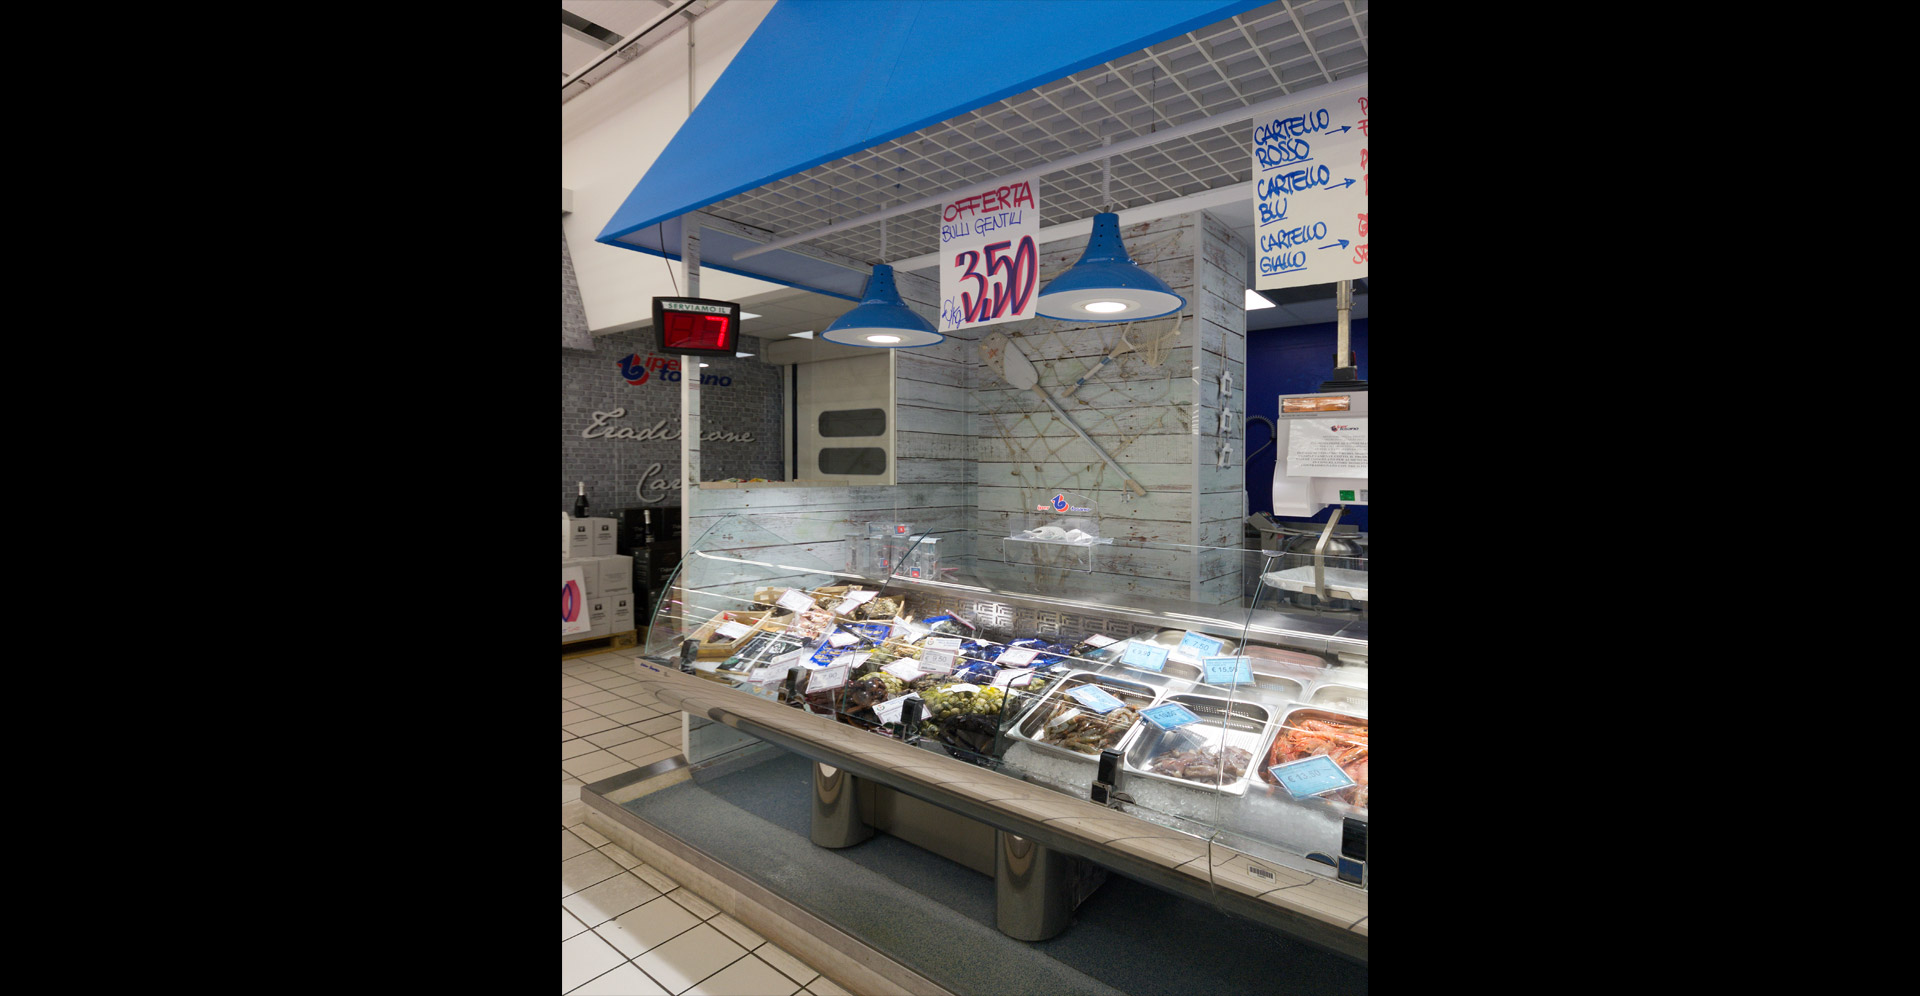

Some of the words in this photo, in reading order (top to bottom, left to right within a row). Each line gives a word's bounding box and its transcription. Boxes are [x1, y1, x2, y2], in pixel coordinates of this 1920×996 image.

[1254, 109, 1330, 146] CARTELLO
[1255, 138, 1310, 168] ROSSO
[1257, 164, 1331, 201] CARTELLO
[943, 181, 1035, 223] OFFERTA
[1258, 197, 1288, 223] BLU
[1260, 221, 1327, 253] CARTELLO
[1259, 251, 1307, 273] GIALLO
[668, 303, 717, 313] SERVIAMO
[704, 315, 729, 348] 7
[644, 352, 682, 374] ipe
[658, 363, 732, 387] toano
